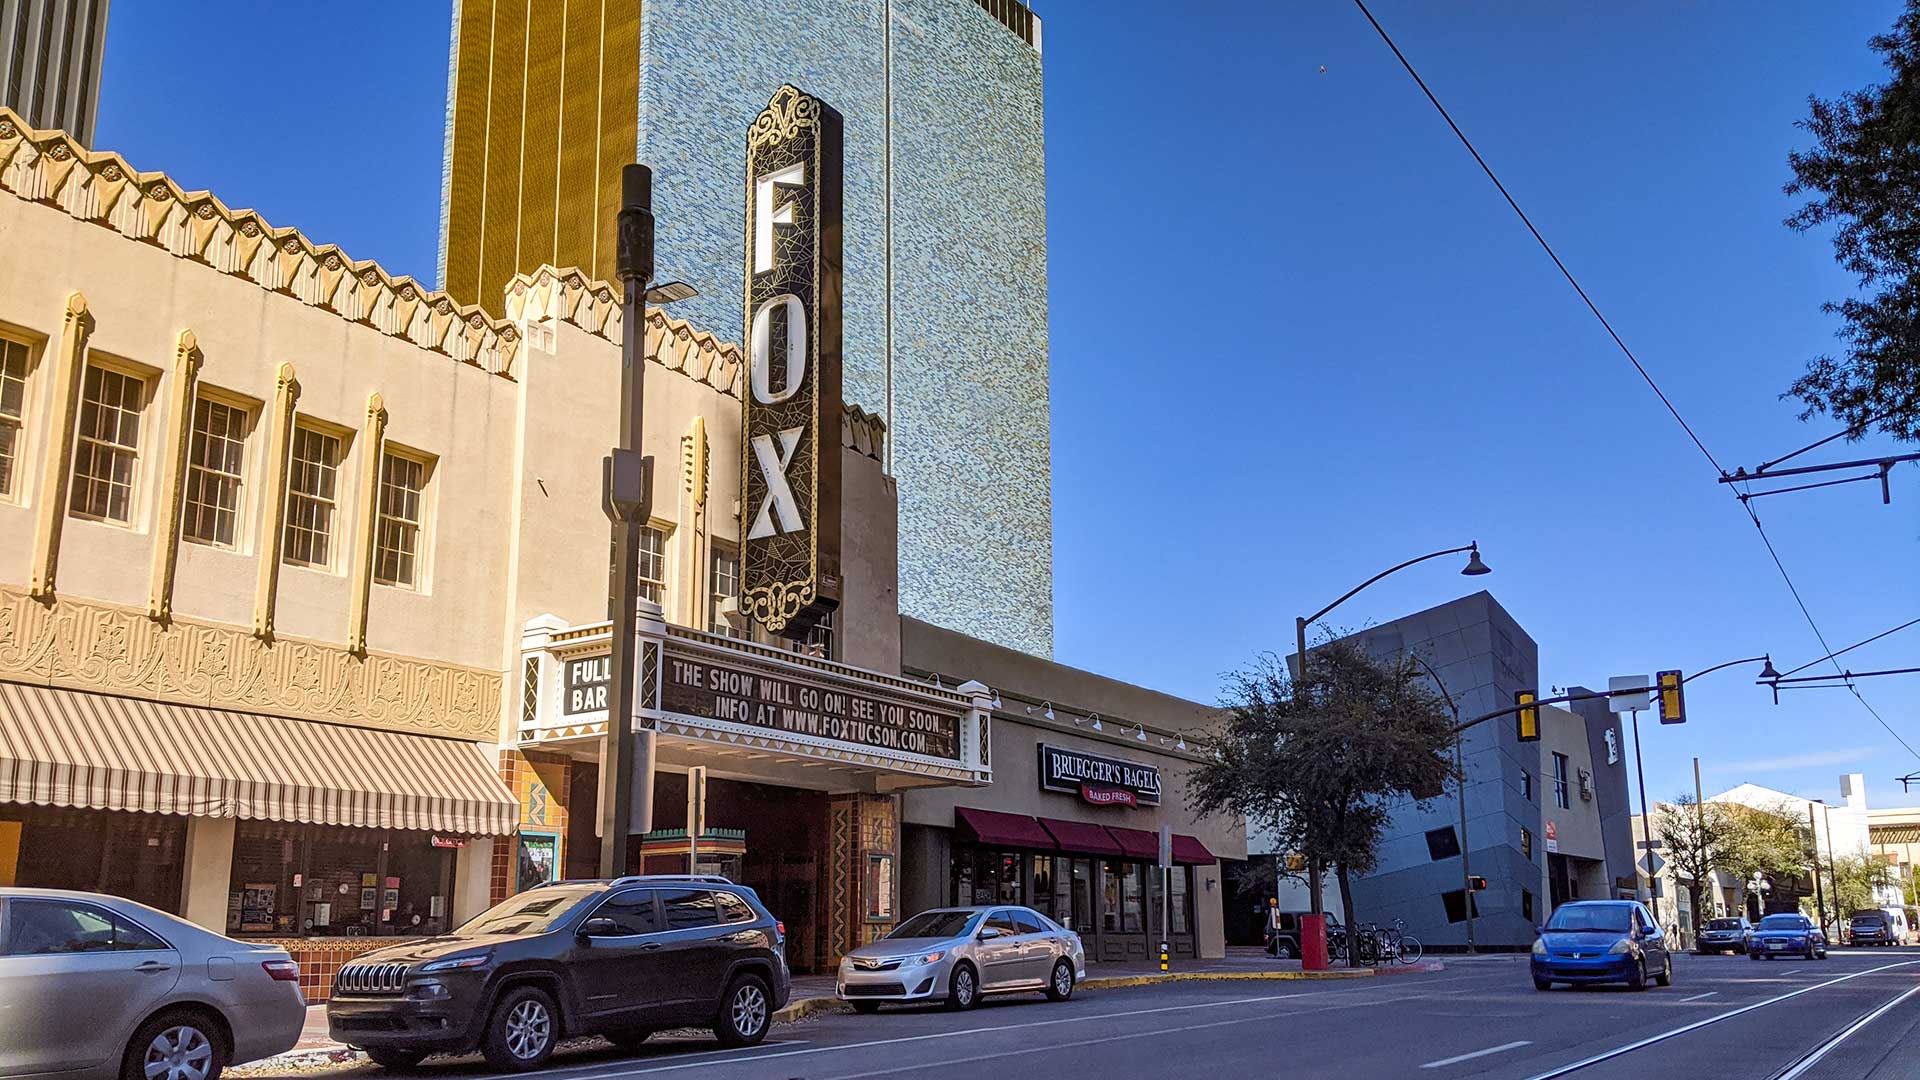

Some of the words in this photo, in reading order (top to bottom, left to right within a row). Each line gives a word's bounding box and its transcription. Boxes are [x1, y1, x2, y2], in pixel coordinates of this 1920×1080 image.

[747, 163, 807, 540] FOX
[572, 657, 611, 685] FULL
[572, 686, 607, 712] BAR
[672, 660, 702, 688] THE
[710, 669, 753, 697] SHOW
[760, 679, 793, 705] WILL
[800, 688, 819, 709] GO
[824, 693, 846, 715] ON!
[852, 698, 874, 720] SEE
[879, 704, 904, 726] YOU
[909, 711, 939, 733] SOON
[715, 696, 749, 721] INFO
[756, 704, 776, 726] AT
[783, 708, 926, 752] WWW.FOXTUCSON.COM
[1052, 753, 1121, 783] BRUEGGER'S
[1124, 767, 1161, 795] BAGELS
[1089, 790, 1111, 801] BAKED
[1111, 792, 1131, 803] FRESH
